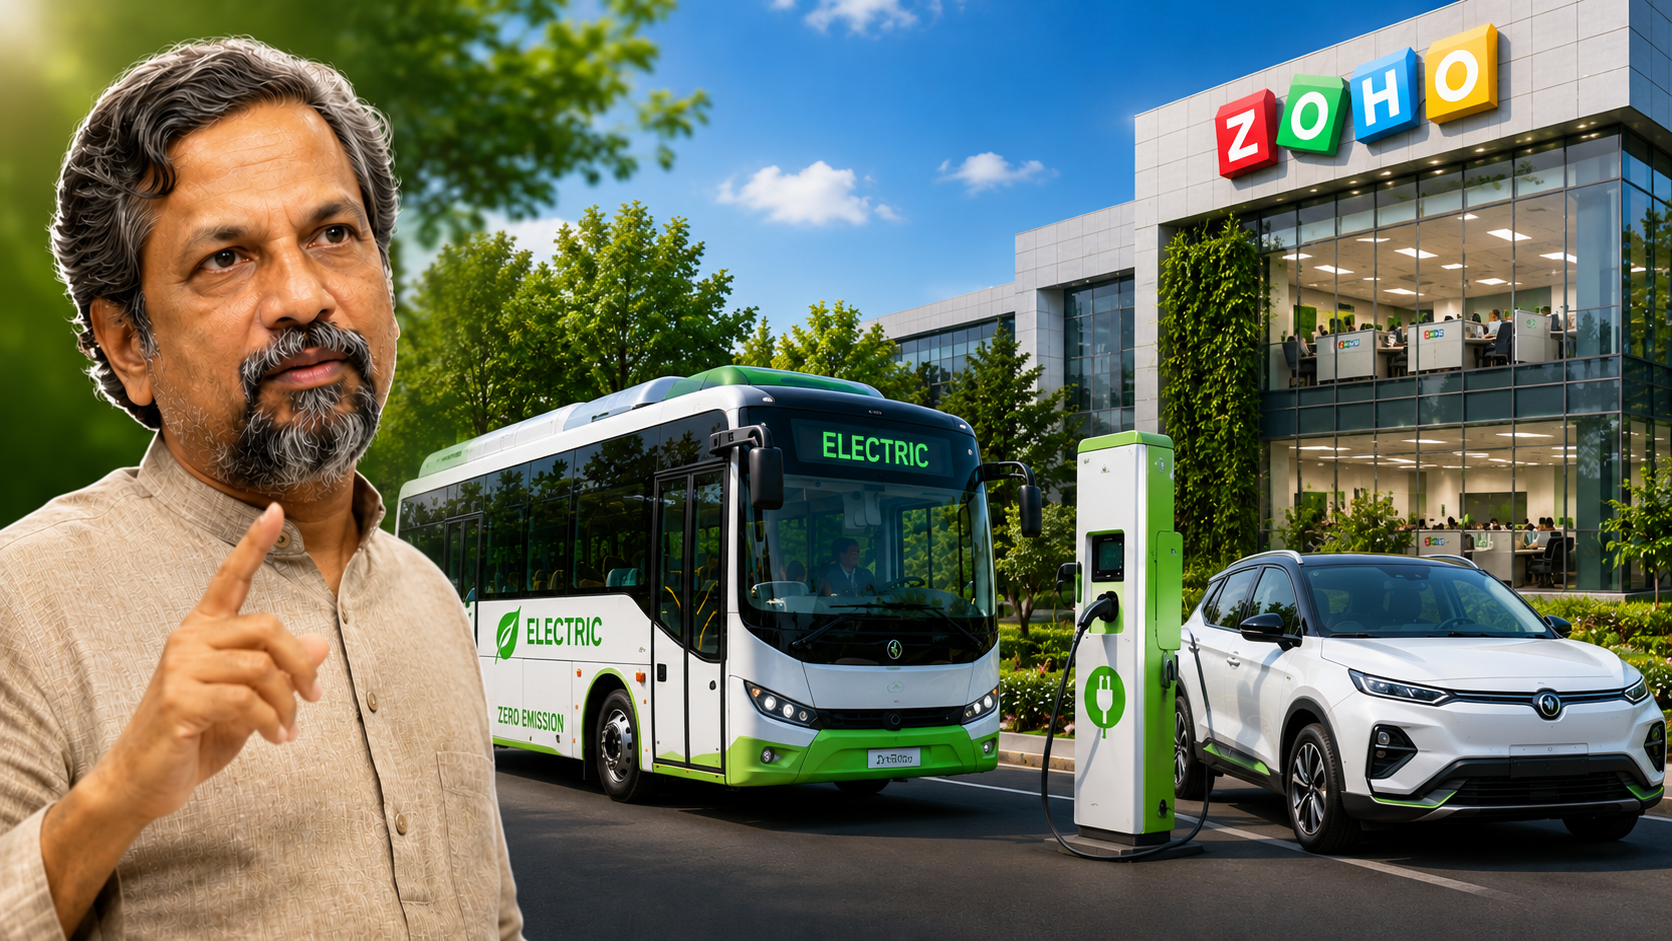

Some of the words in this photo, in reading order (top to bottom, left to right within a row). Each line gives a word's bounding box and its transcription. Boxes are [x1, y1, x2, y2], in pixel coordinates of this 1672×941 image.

[1226, 49, 1479, 163] ZOHO
[822, 431, 929, 468] ELECTRIC
[526, 616, 603, 647] ELECTRIC
[497, 705, 520, 726] ZERO
[521, 708, 564, 733] EMISSION
